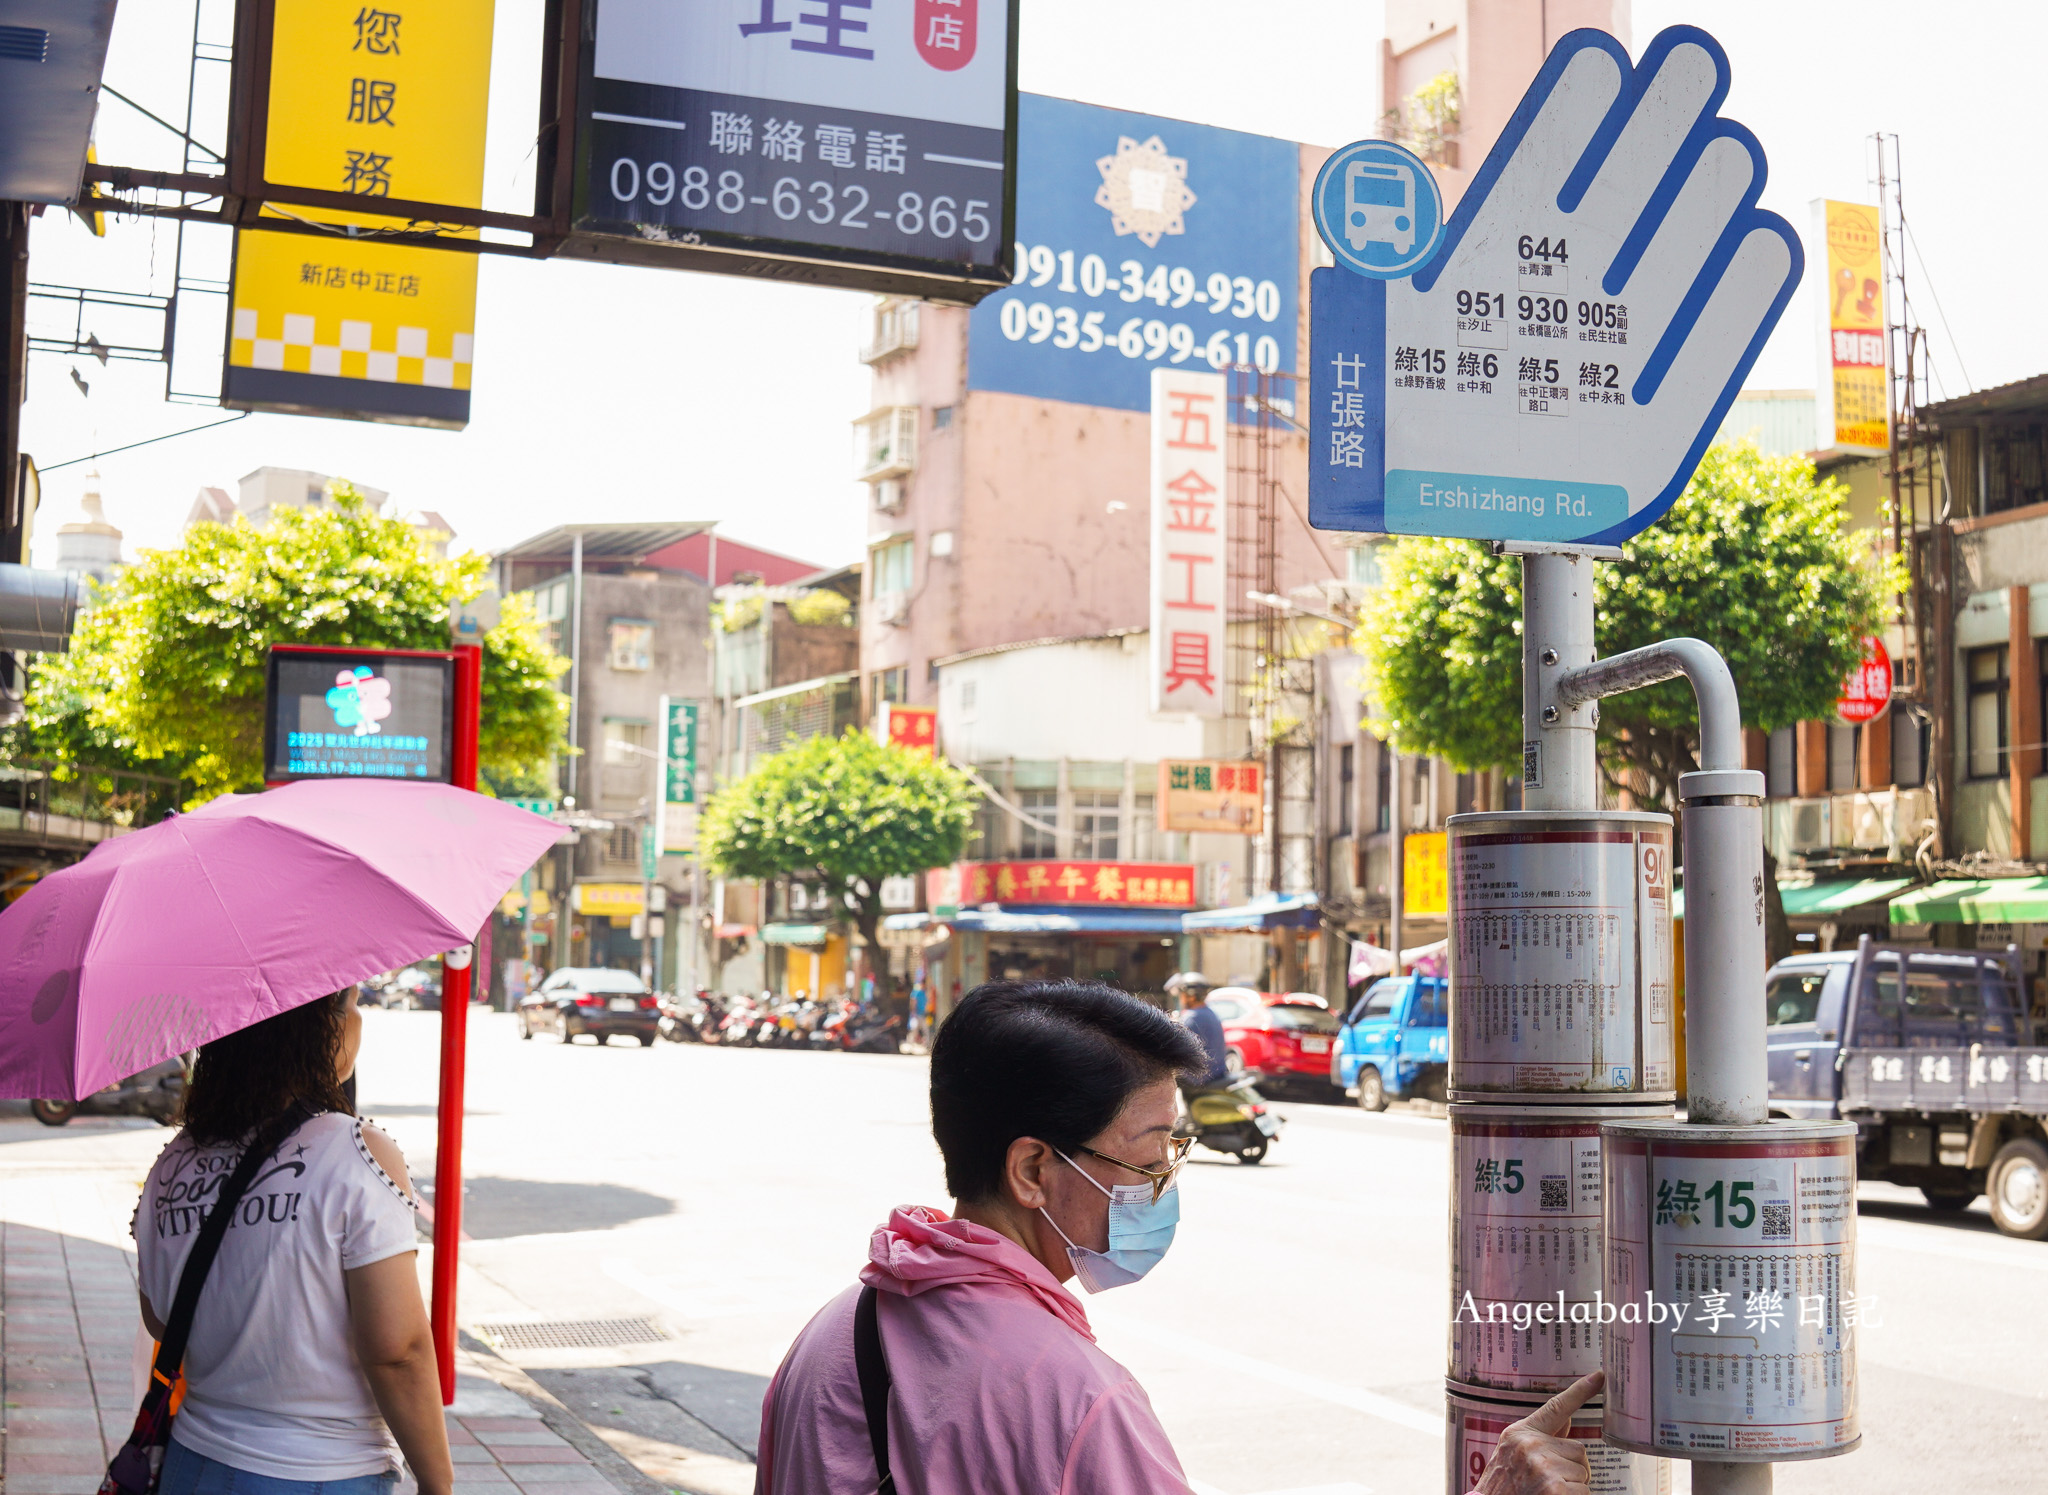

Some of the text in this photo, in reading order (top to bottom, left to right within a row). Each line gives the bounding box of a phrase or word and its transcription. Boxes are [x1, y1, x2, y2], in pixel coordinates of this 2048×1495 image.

[709, 110, 907, 175] 聯絡電話
[609, 157, 991, 244] 0988-632-865
[1518, 235, 1568, 263] 644
[299, 261, 421, 298] 新店中正店
[1519, 263, 1553, 278] 往青潭
[1457, 290, 1505, 319] 951
[1518, 296, 1568, 324] 930
[1000, 299, 1280, 375] 0935-699-610
[1458, 319, 1492, 334] 往汐止
[1518, 323, 1568, 340] 往板橋區公所
[1579, 330, 1628, 345] 往民生社區
[1394, 346, 1446, 374] 綠15
[1832, 330, 1884, 366] 刻印
[1457, 351, 1499, 378] 綠6
[1518, 356, 1560, 384] 綠5
[1579, 361, 1620, 389] 綠2
[1394, 375, 1446, 391] 往綠野香坡
[1457, 379, 1492, 394] 往中和
[1519, 385, 1569, 401] 往中正環河
[1330, 352, 1366, 469] 廿張路
[1528, 398, 1549, 412] 路口
[1579, 390, 1626, 406] 往中永和
[1419, 483, 1592, 516] Ershizhang Rd.
[1166, 390, 1217, 696] 五金工具
[1474, 1158, 1525, 1195] 綠5
[1656, 1178, 1756, 1229] 綠15
